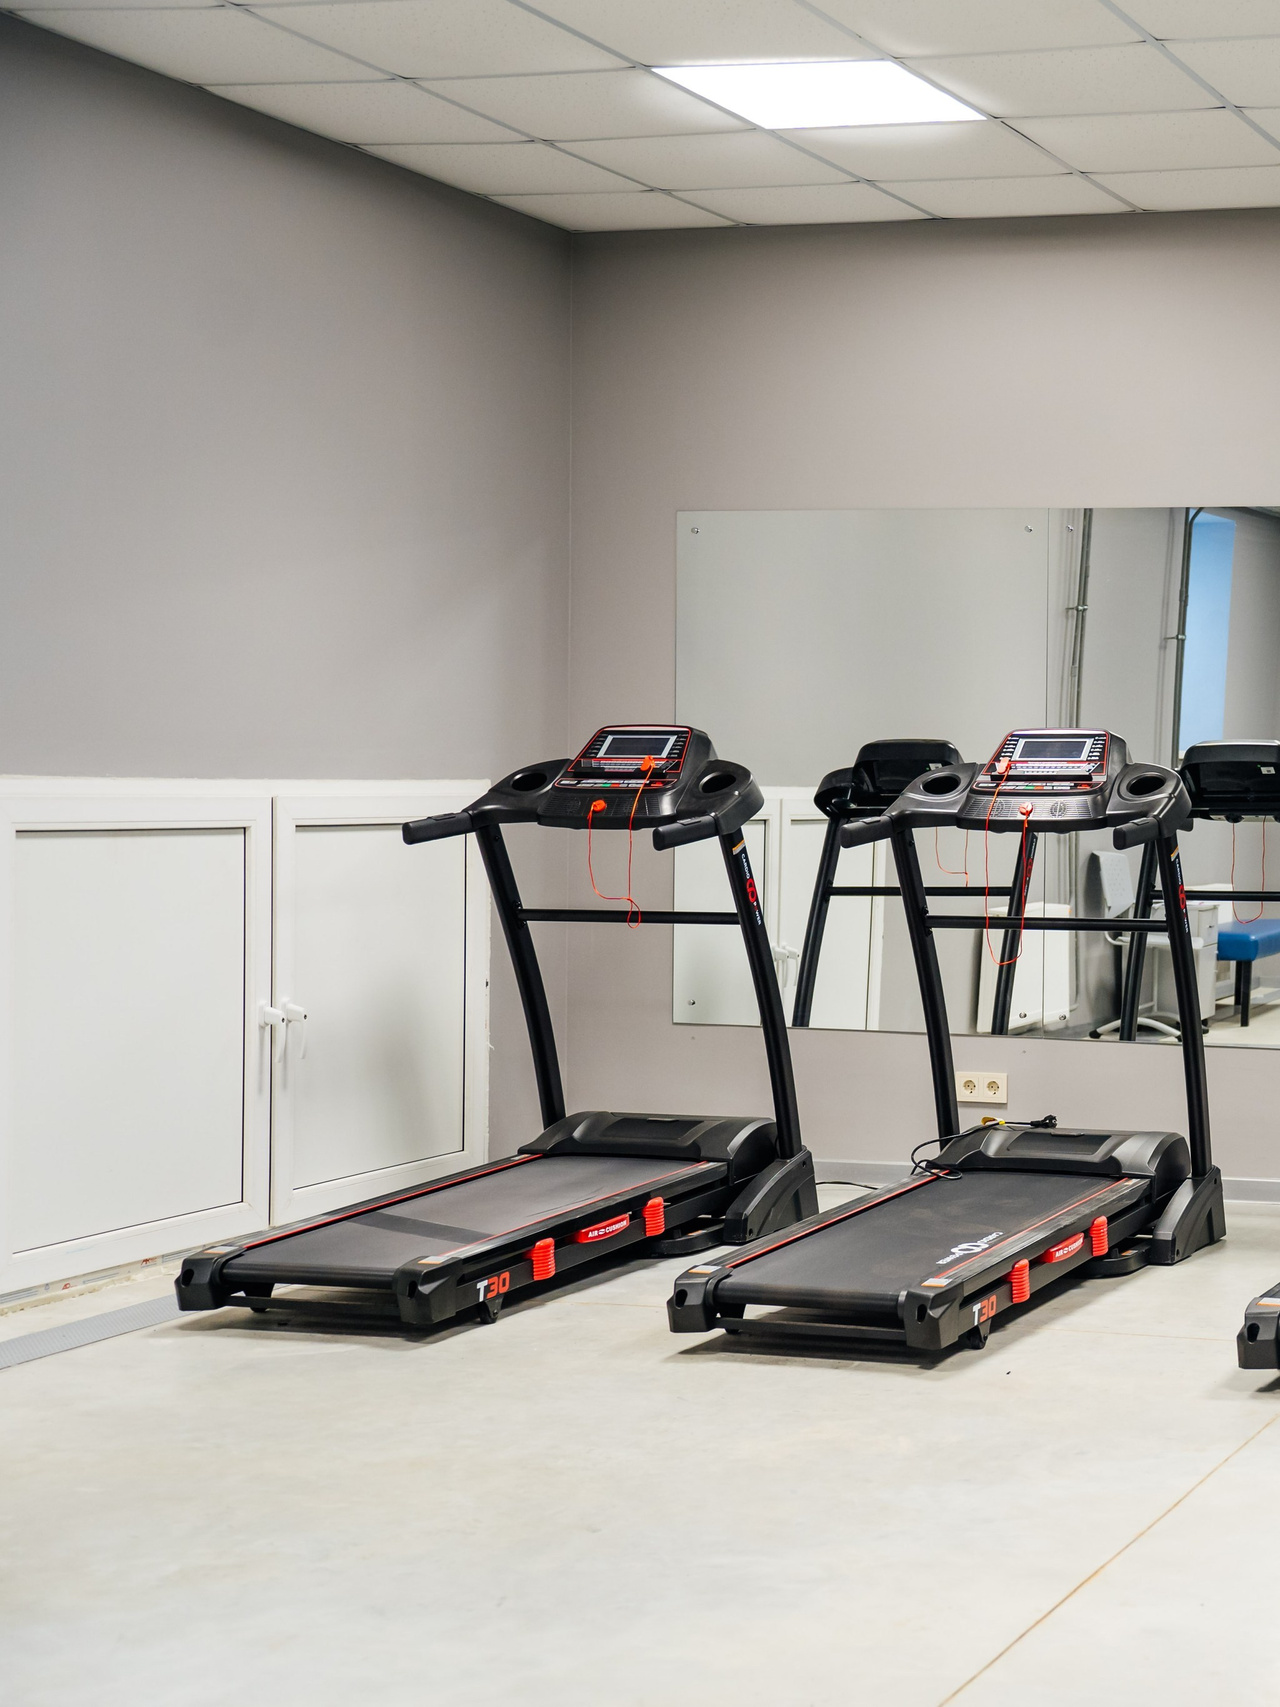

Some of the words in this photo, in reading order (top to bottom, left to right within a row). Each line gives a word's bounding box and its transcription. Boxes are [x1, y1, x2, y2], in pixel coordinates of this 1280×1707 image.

[588, 1230, 599, 1238] AIR
[605, 1219, 627, 1233] CUSHION
[476, 1271, 510, 1302] T30
[972, 1294, 997, 1326] T30
